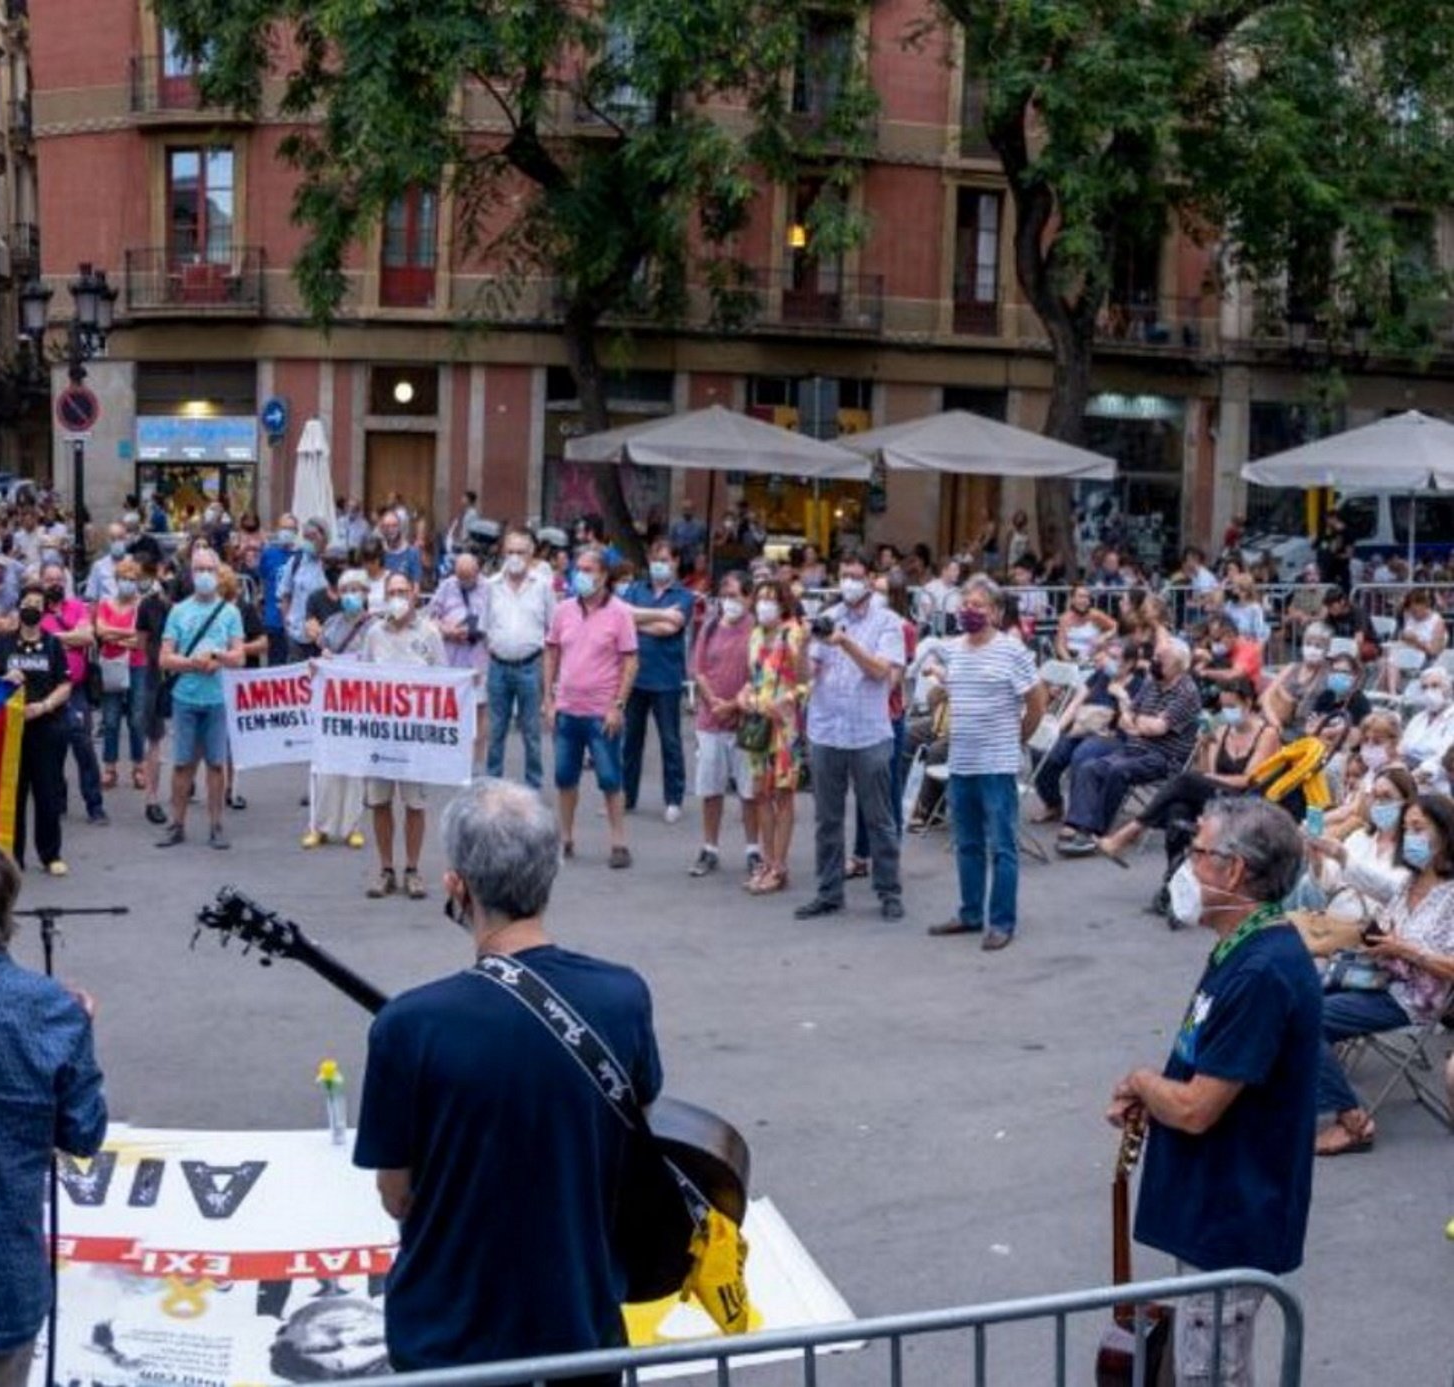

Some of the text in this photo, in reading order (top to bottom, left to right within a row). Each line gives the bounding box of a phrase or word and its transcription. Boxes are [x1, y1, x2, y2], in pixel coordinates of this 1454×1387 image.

[321, 677, 460, 722] AMNISTIA
[321, 716, 459, 746] FEM-NOS LLIURES
